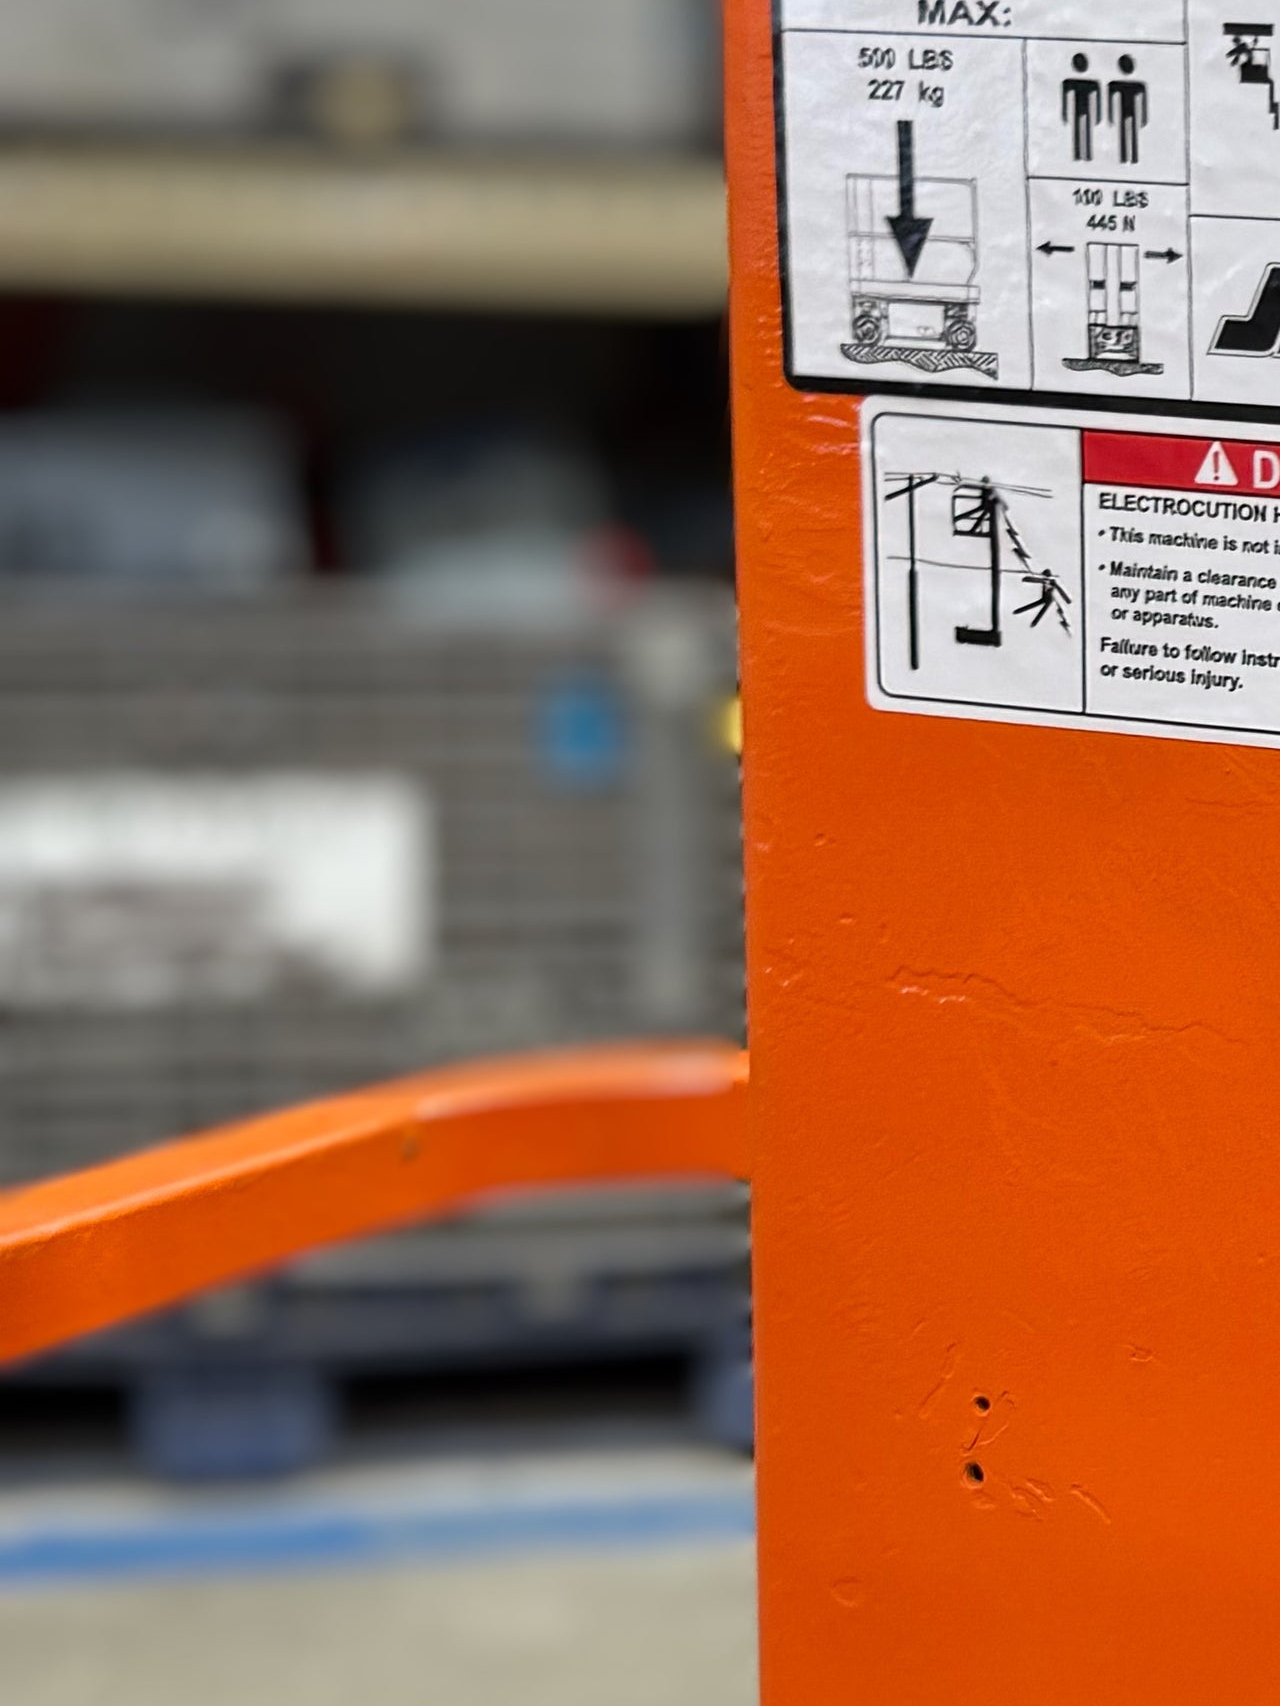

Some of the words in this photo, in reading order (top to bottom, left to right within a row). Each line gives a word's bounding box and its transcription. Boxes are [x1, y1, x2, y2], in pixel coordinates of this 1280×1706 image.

[857, 46, 896, 70] 500
[907, 47, 954, 71] LBS
[866, 77, 906, 101] 227
[917, 80, 945, 108] kg
[1071, 187, 1103, 207] 100
[1111, 189, 1149, 209] LBS
[1085, 213, 1117, 231] 445
[1121, 214, 1136, 232] N
[1097, 491, 1267, 522] ELECTROCUTION
[1108, 524, 1144, 544] This
[1147, 531, 1219, 550] machine
[1221, 534, 1238, 552] is
[1240, 539, 1270, 555] not
[1108, 559, 1178, 582] Maintain
[1181, 569, 1193, 583] a
[1196, 568, 1277, 590] clearance
[1109, 585, 1141, 604] any
[1143, 588, 1178, 605] part
[1180, 588, 1199, 605] of
[1200, 593, 1272, 612] machine
[1109, 607, 1129, 620] or
[1131, 609, 1219, 629] apparatus.
[1099, 635, 1158, 657] Failure
[1161, 641, 1181, 659] to
[1183, 643, 1238, 664] follow
[1098, 663, 1119, 678] or
[1121, 664, 1186, 684] serious
[1189, 667, 1244, 692] injury.
